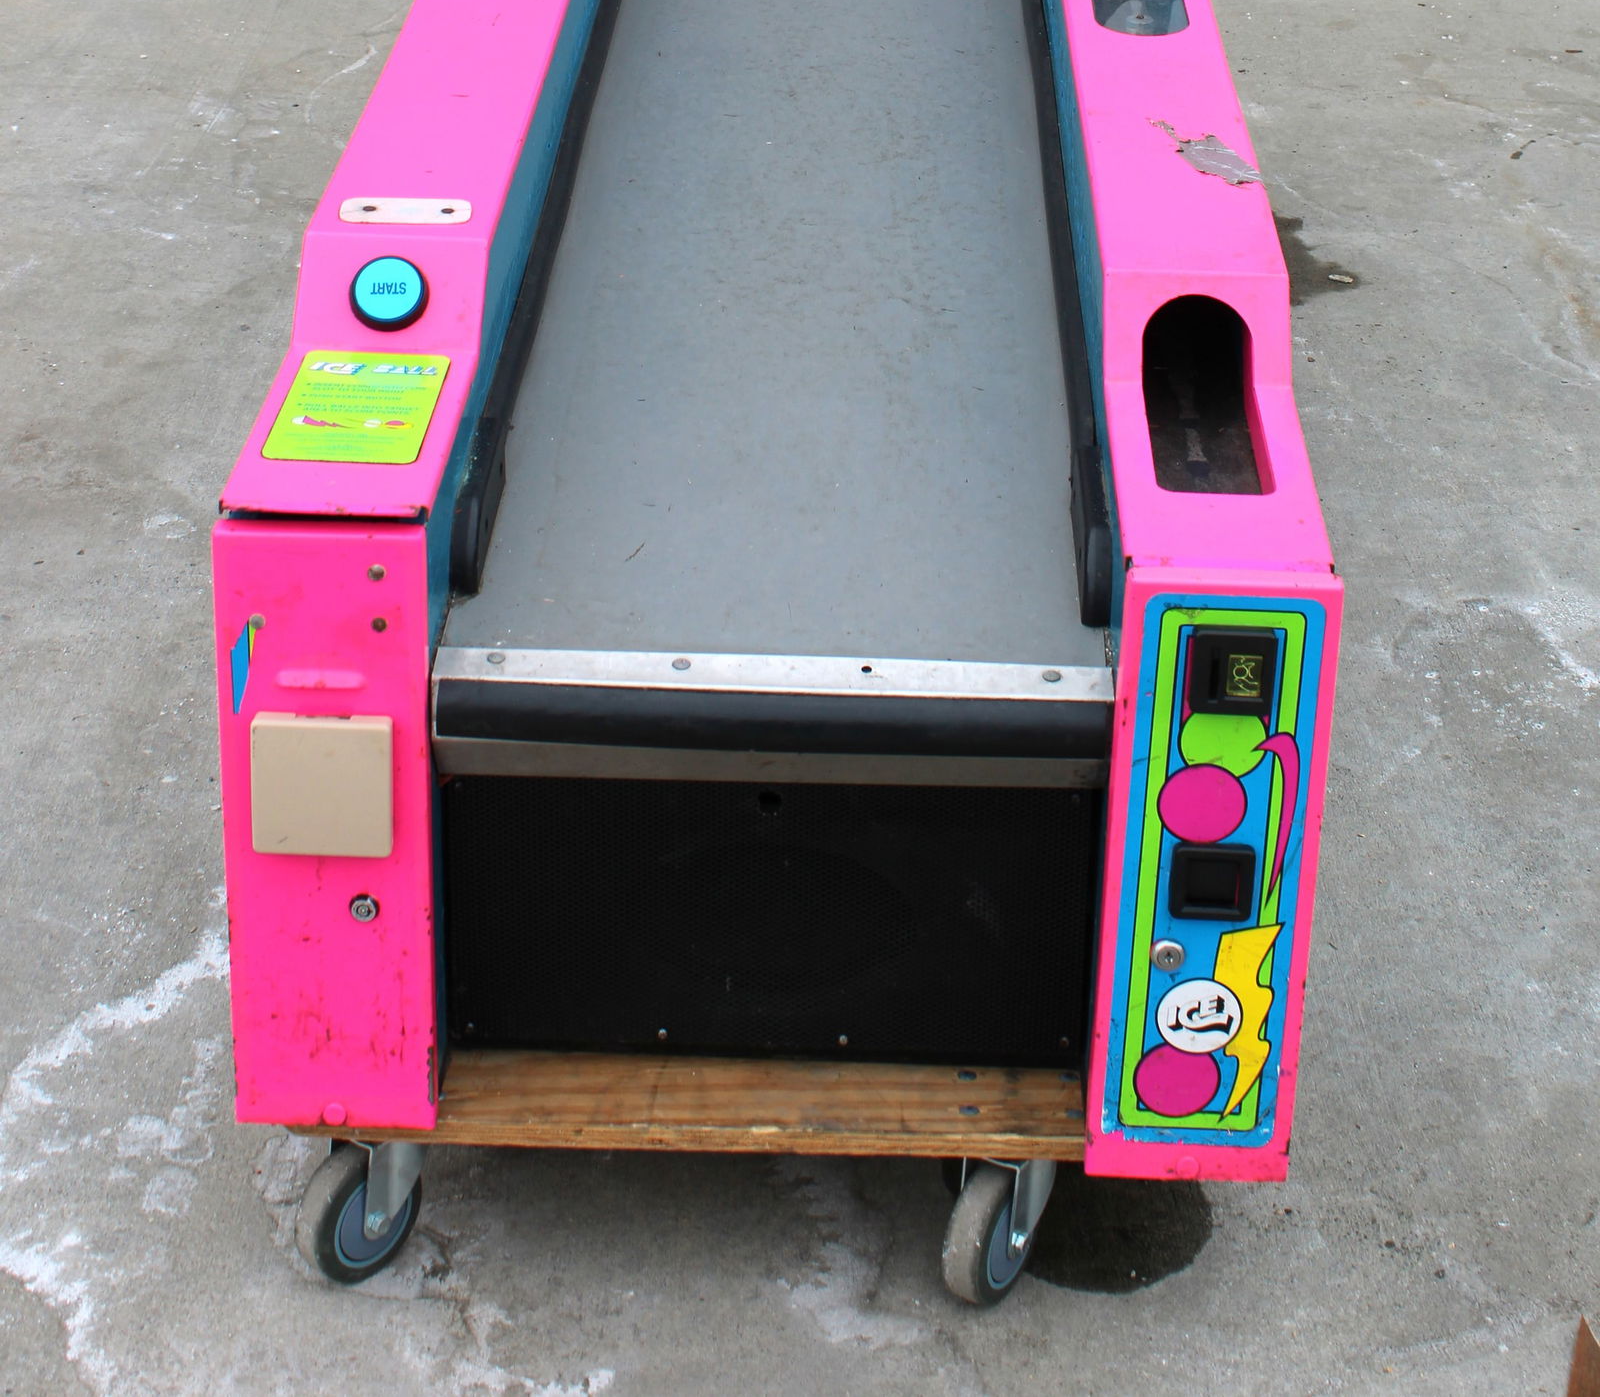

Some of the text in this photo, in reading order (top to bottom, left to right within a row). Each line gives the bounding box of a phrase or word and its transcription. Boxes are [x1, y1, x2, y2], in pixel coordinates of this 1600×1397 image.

[370, 281, 407, 295] START
[309, 361, 438, 377] ICE BALL
[1167, 994, 1234, 1035] ICE
